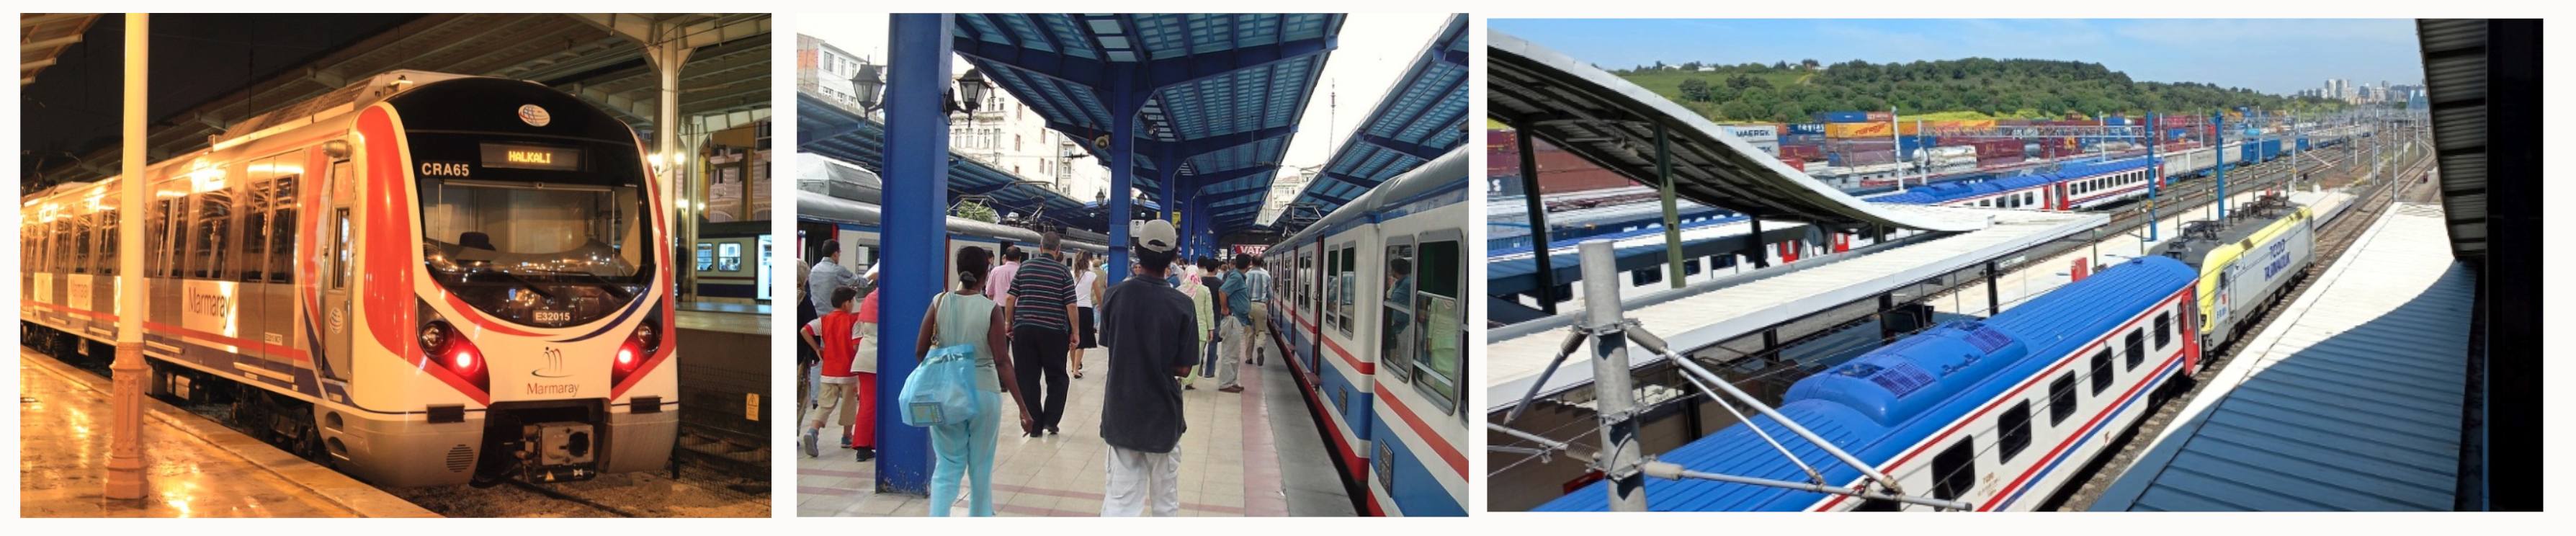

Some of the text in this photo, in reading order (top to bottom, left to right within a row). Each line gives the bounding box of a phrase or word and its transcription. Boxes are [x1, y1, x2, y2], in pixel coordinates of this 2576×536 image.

[508, 151, 551, 164] HALKALI
[421, 162, 469, 177] CRA65
[189, 287, 231, 330] Marmaray
[535, 312, 571, 321] E32015
[527, 382, 580, 398] Marmaray
